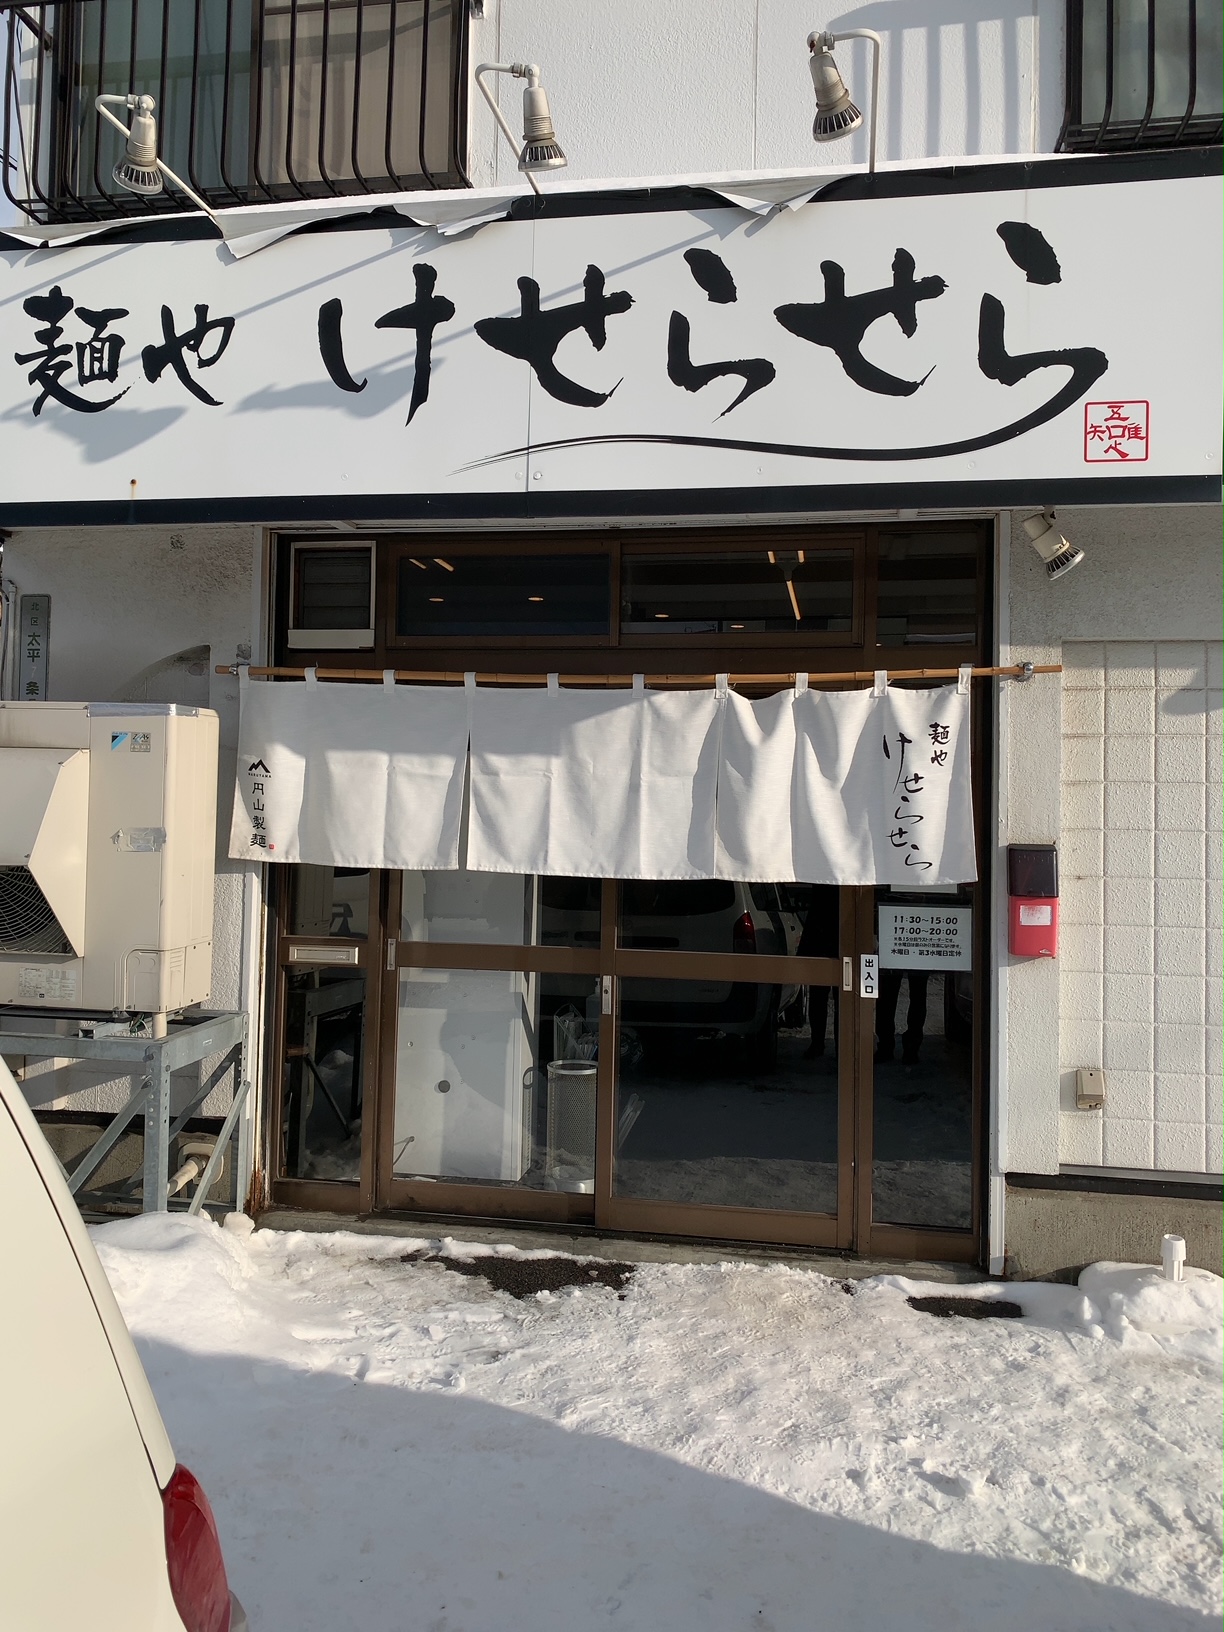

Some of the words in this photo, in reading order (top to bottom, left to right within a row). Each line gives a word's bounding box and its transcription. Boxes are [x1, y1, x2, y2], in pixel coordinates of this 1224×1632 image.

[15, 285, 236, 417] 麺や
[318, 221, 1109, 462] けせらせら
[928, 722, 951, 766] 麺や
[250, 782, 267, 848] 円山製麺
[883, 732, 933, 871] けせらせら
[864, 958, 874, 994] 出入口
